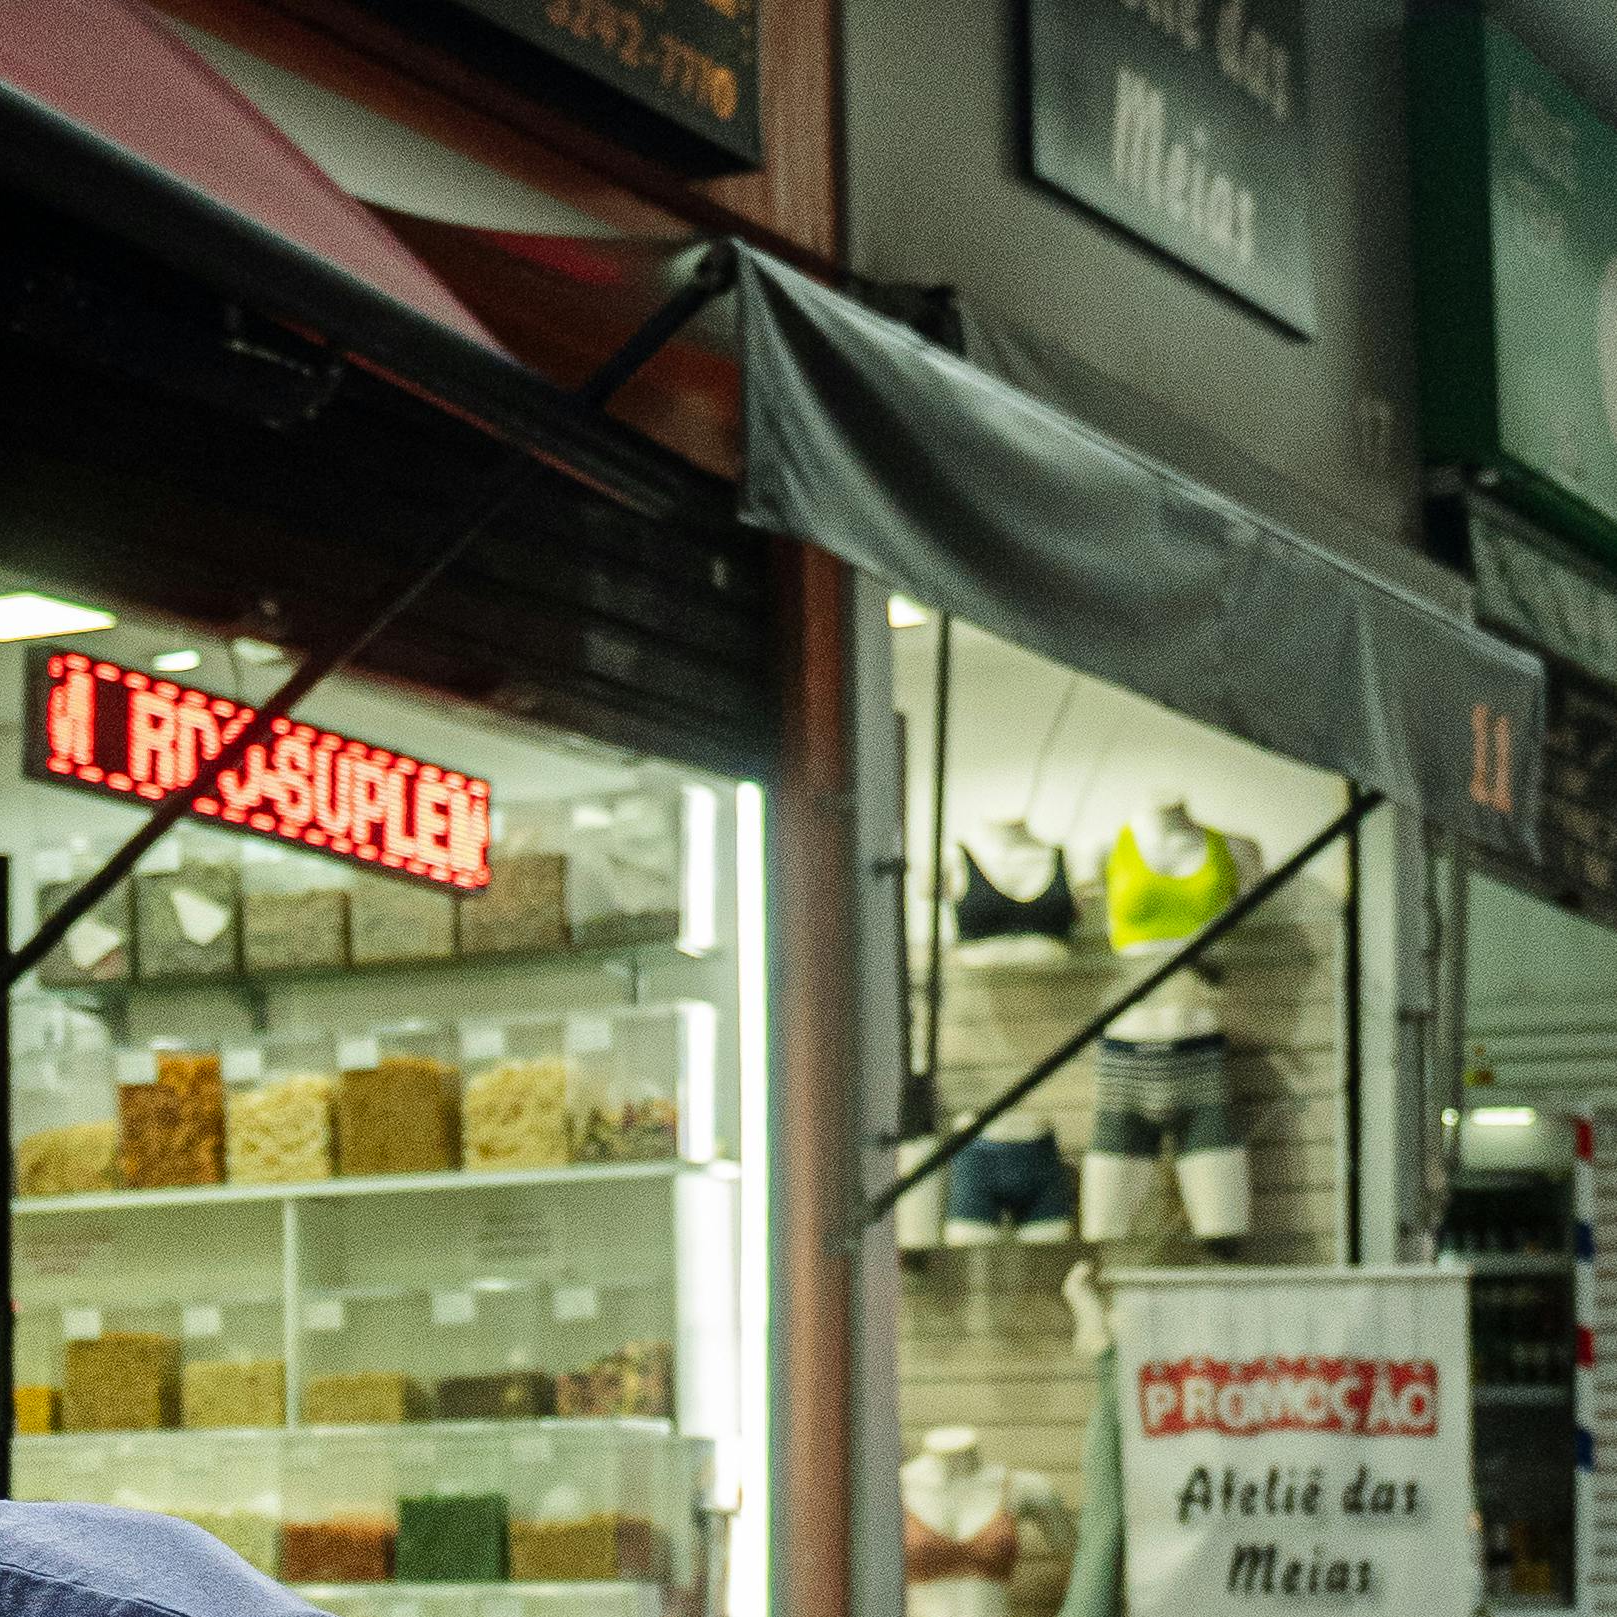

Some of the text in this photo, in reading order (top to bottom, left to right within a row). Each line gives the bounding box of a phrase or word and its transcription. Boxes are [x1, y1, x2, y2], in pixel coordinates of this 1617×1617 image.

[1110, 62, 1257, 268] Meias
[1342, 1463, 1419, 1517] das
[1227, 1544, 1372, 1594] Meias
